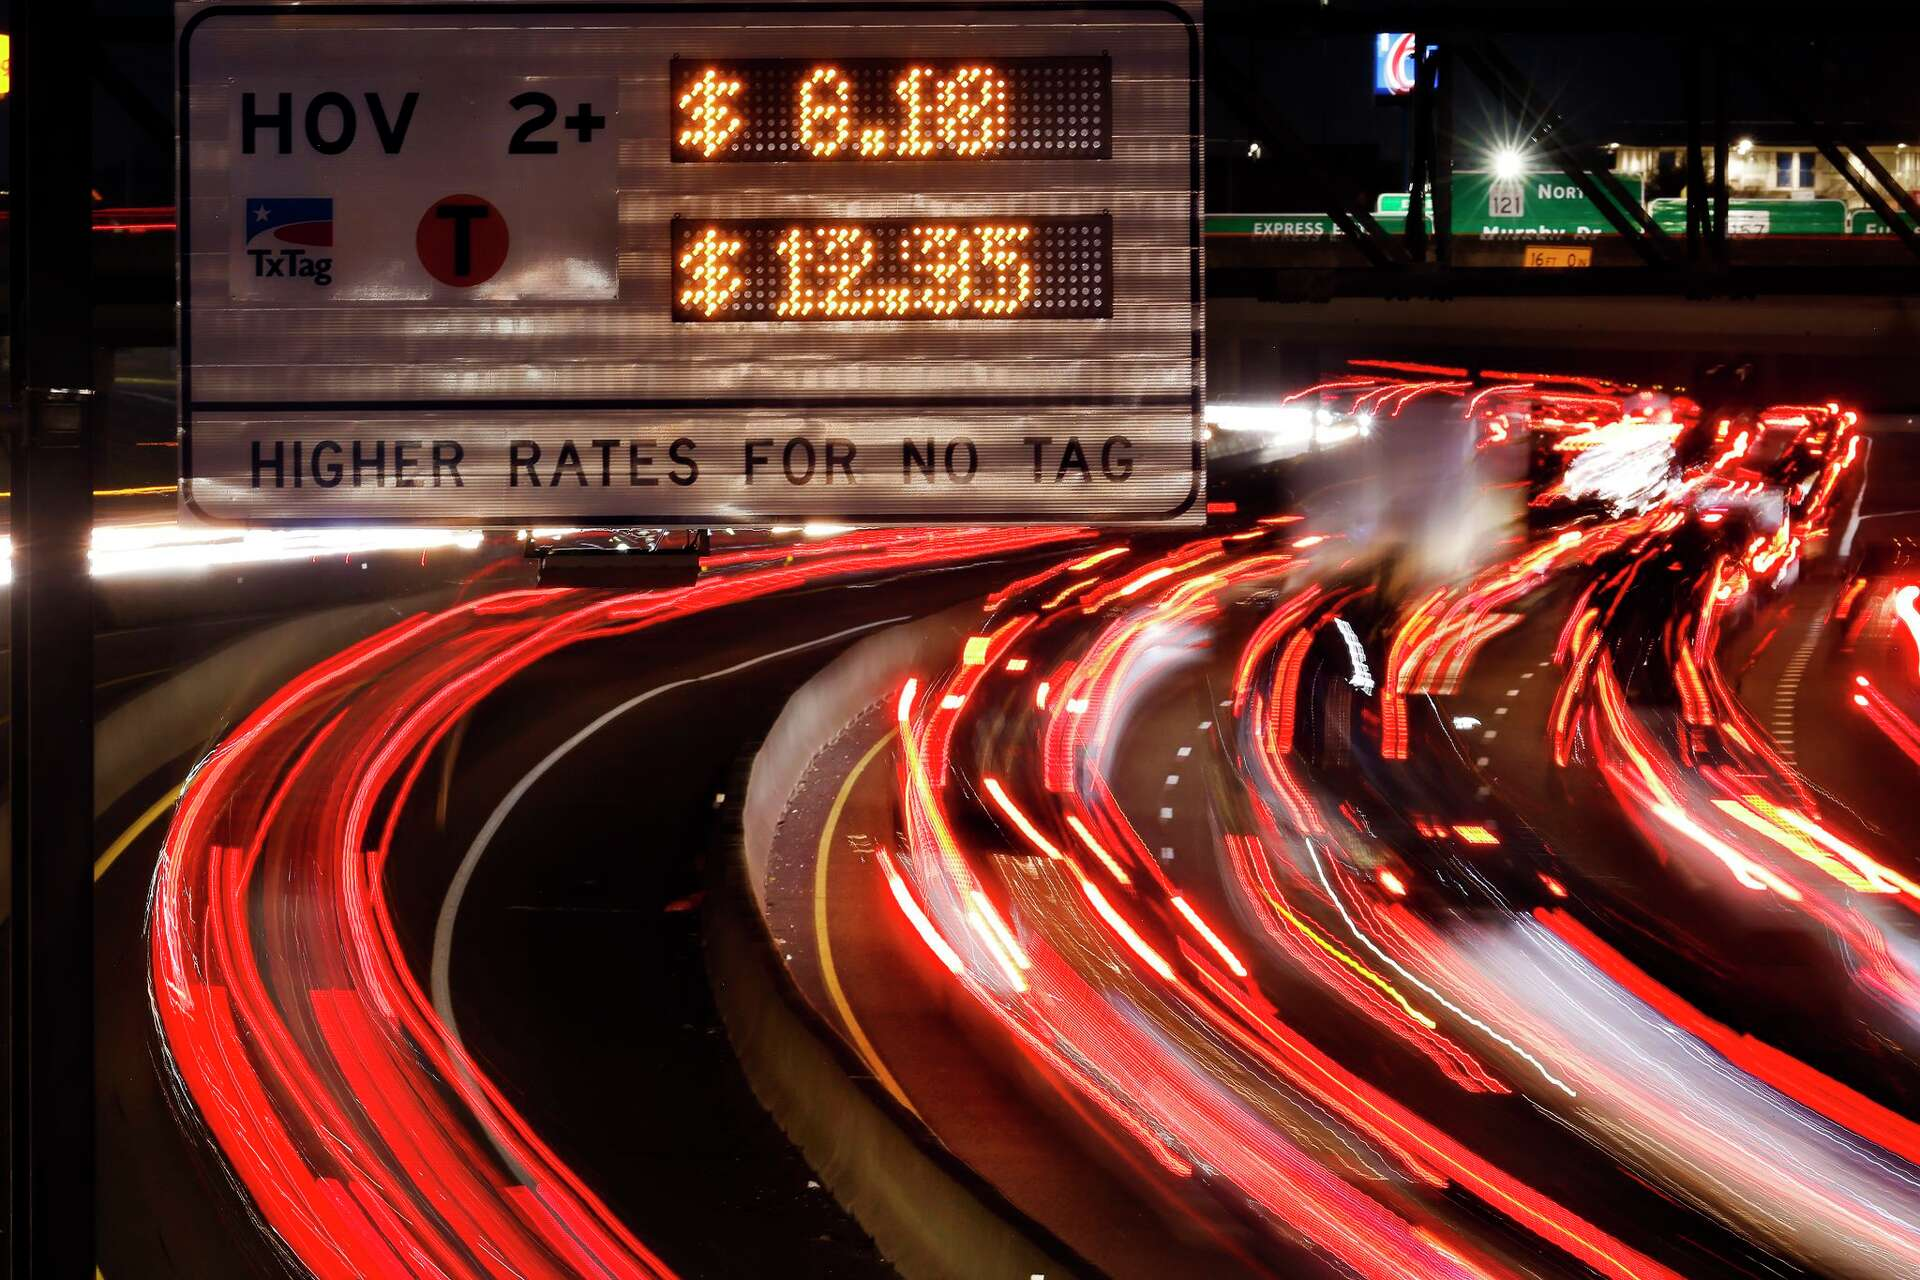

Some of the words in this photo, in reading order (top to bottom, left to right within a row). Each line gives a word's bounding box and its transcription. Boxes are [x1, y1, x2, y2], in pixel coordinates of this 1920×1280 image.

[241, 91, 419, 155] HOV
[508, 91, 605, 155] 2+
[1494, 197, 1520, 214] 121
[436, 205, 489, 276] T
[1253, 222, 1324, 235] EXPRESS
[247, 249, 332, 285] TxTag
[251, 440, 464, 488] HIGHER
[510, 438, 699, 487] RATES
[744, 437, 857, 486] FOR
[903, 436, 978, 485] NO
[1023, 435, 1134, 484] TAG
